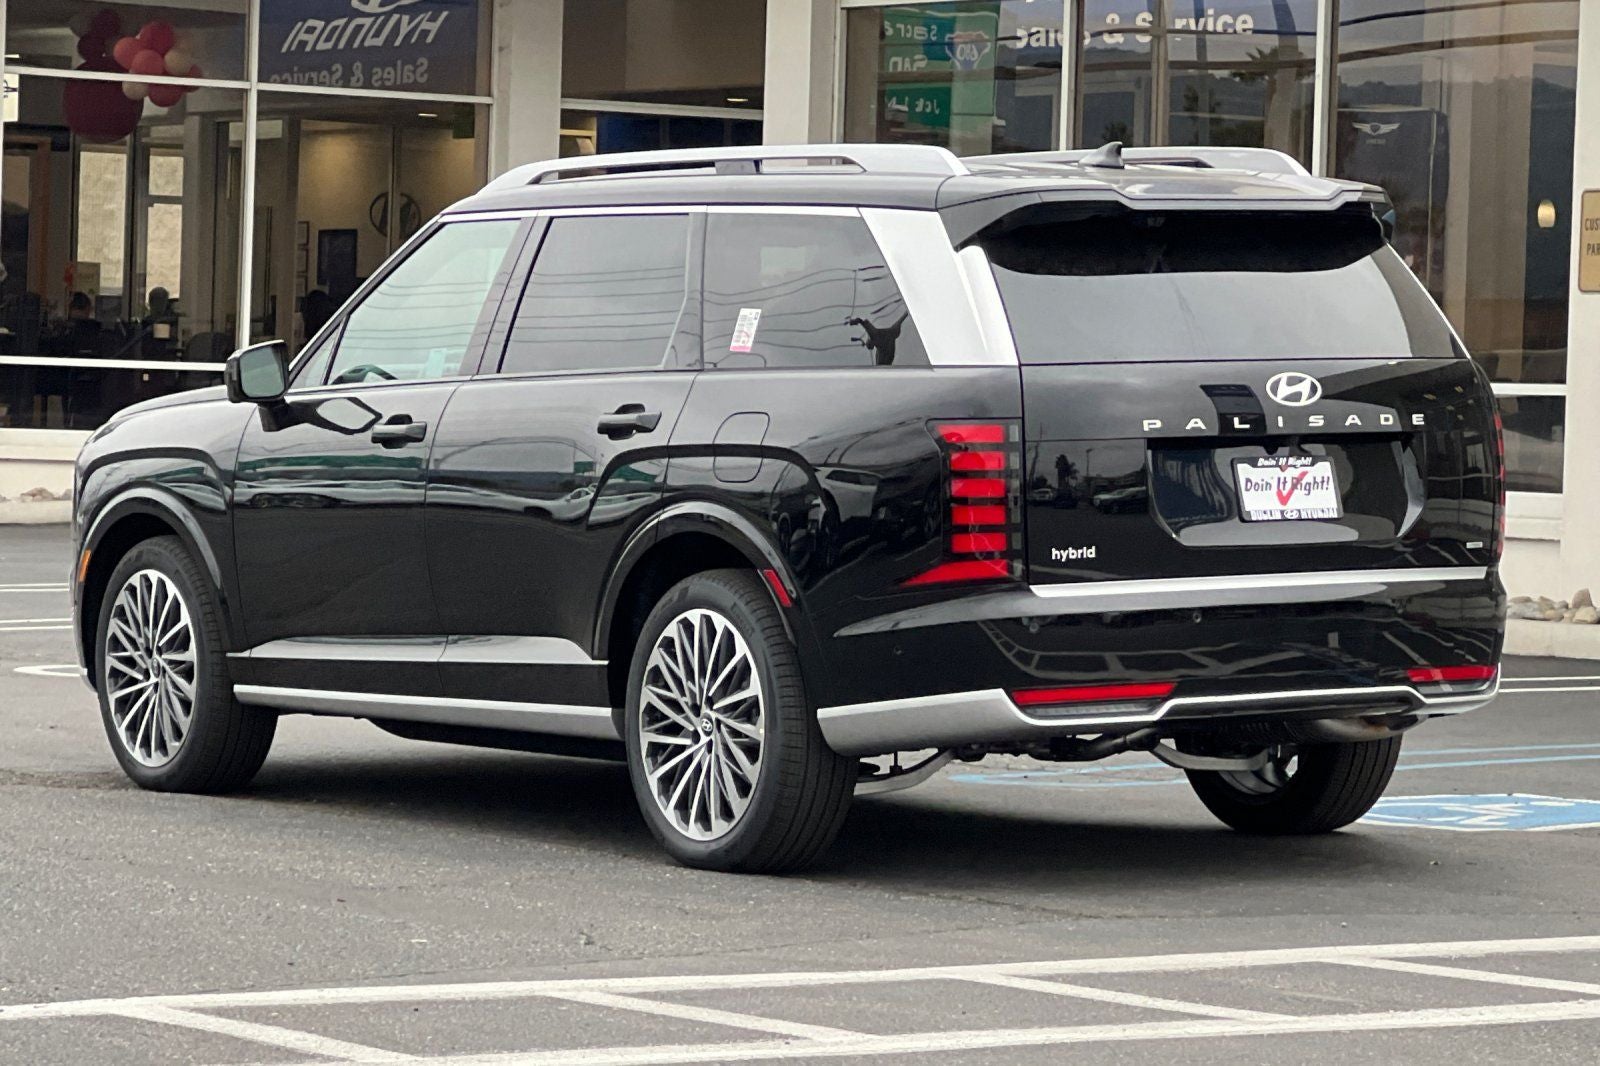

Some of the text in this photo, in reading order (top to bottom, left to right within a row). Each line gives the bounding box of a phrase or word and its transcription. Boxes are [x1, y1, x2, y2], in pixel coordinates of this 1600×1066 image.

[1135, 9, 1254, 43] Srvice
[1143, 413, 1425, 432] PALISADE
[1277, 476, 1288, 491] It
[1290, 475, 1331, 496] Right!
[1051, 545, 1096, 562] hybrid
